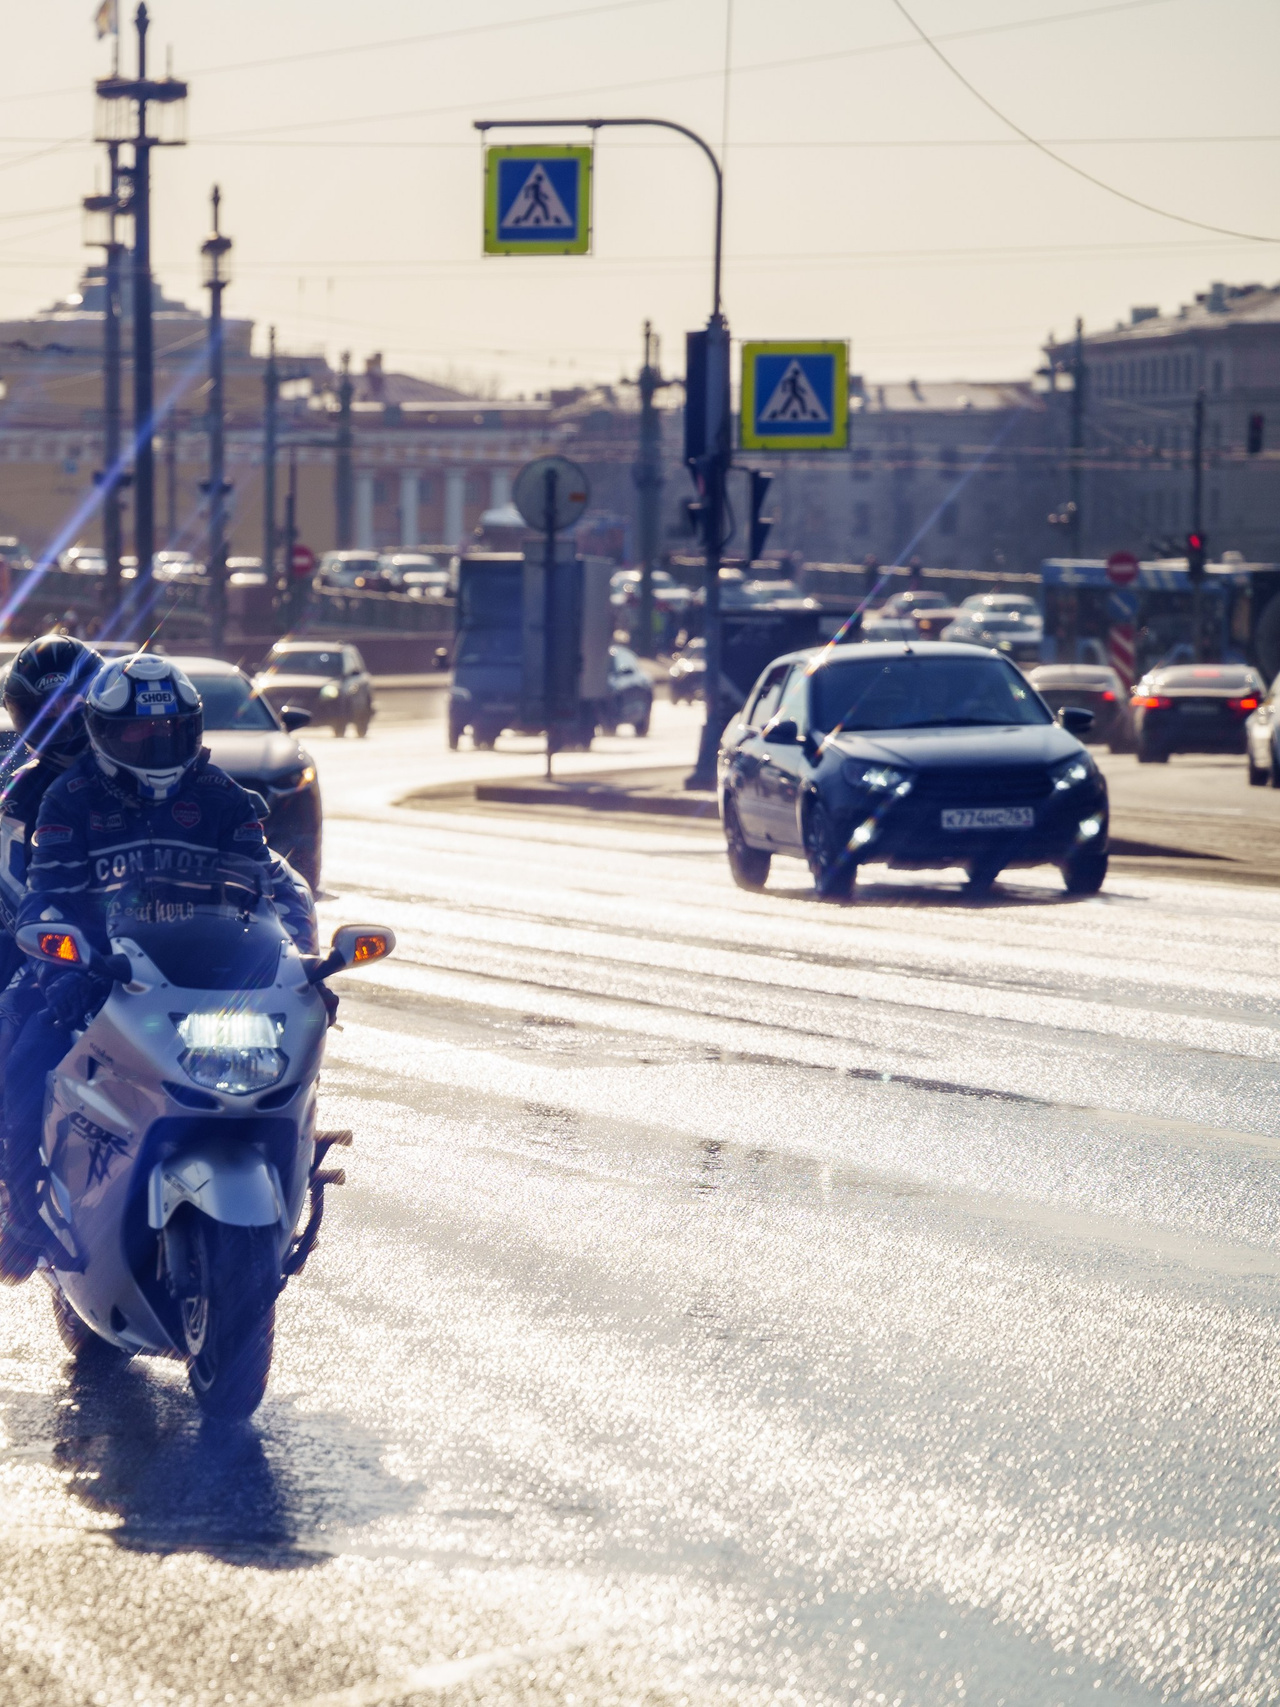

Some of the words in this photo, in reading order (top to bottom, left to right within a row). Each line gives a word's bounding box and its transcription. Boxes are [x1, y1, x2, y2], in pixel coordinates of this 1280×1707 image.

[36, 674, 68, 690] Airoh
[140, 692, 171, 704] SHOEI
[95, 850, 144, 881] CON
